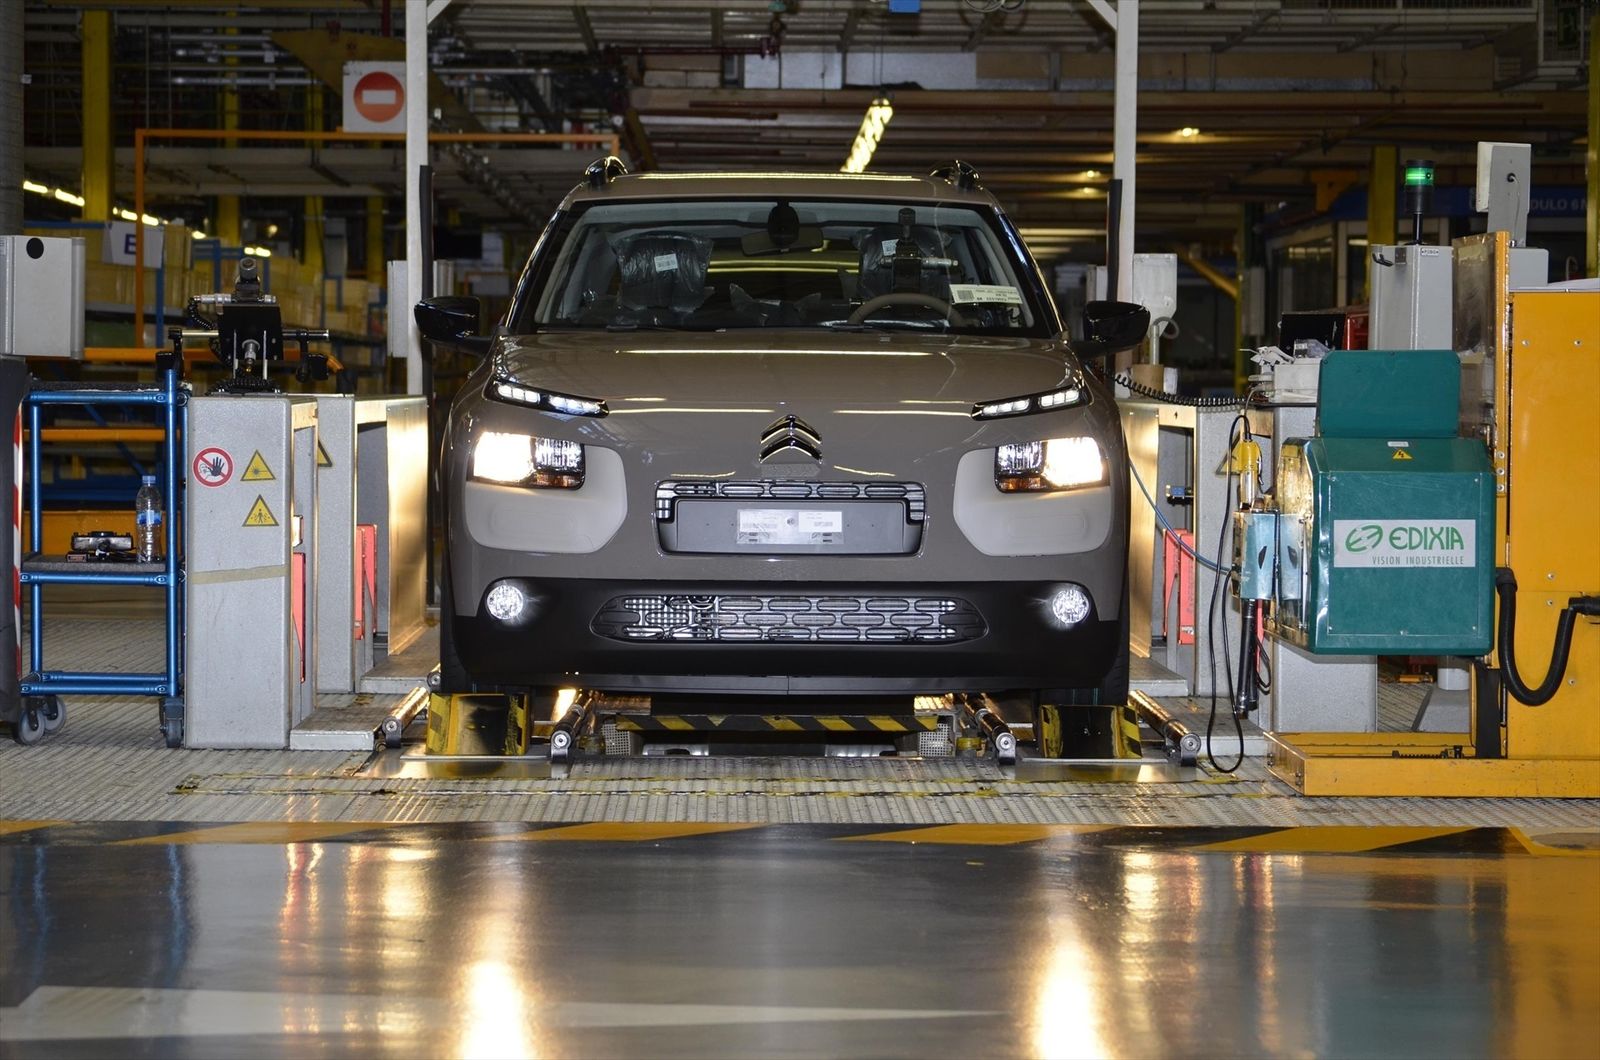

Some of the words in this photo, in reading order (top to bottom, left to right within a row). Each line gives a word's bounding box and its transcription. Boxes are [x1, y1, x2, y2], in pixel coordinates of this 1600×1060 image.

[1389, 526, 1464, 550] EDIXIA
[1372, 556, 1400, 565] VISION
[1406, 556, 1464, 565] INDUSTRIELLE
